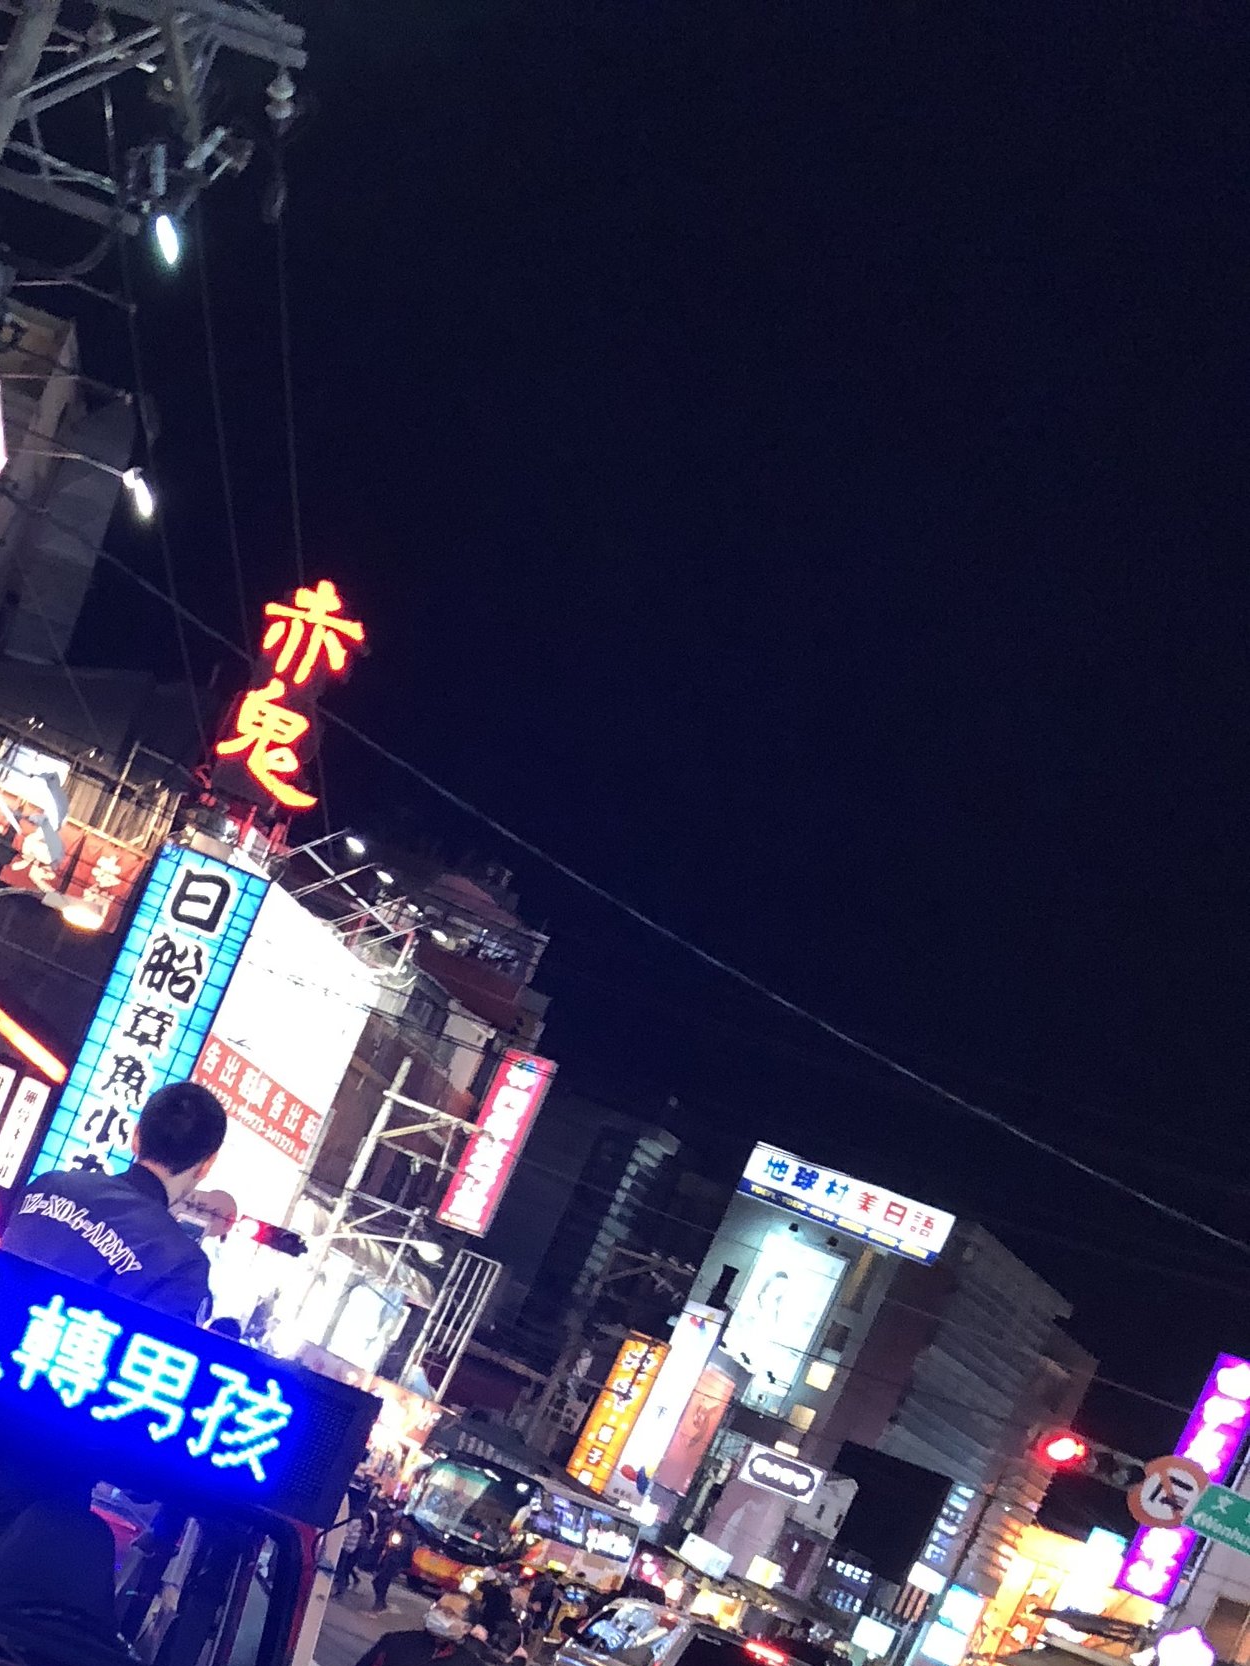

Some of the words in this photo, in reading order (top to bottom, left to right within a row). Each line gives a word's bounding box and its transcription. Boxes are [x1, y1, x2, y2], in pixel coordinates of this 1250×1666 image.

[217, 580, 365, 808] 赤鬼
[763, 1155, 936, 1238] 地球村美日語
